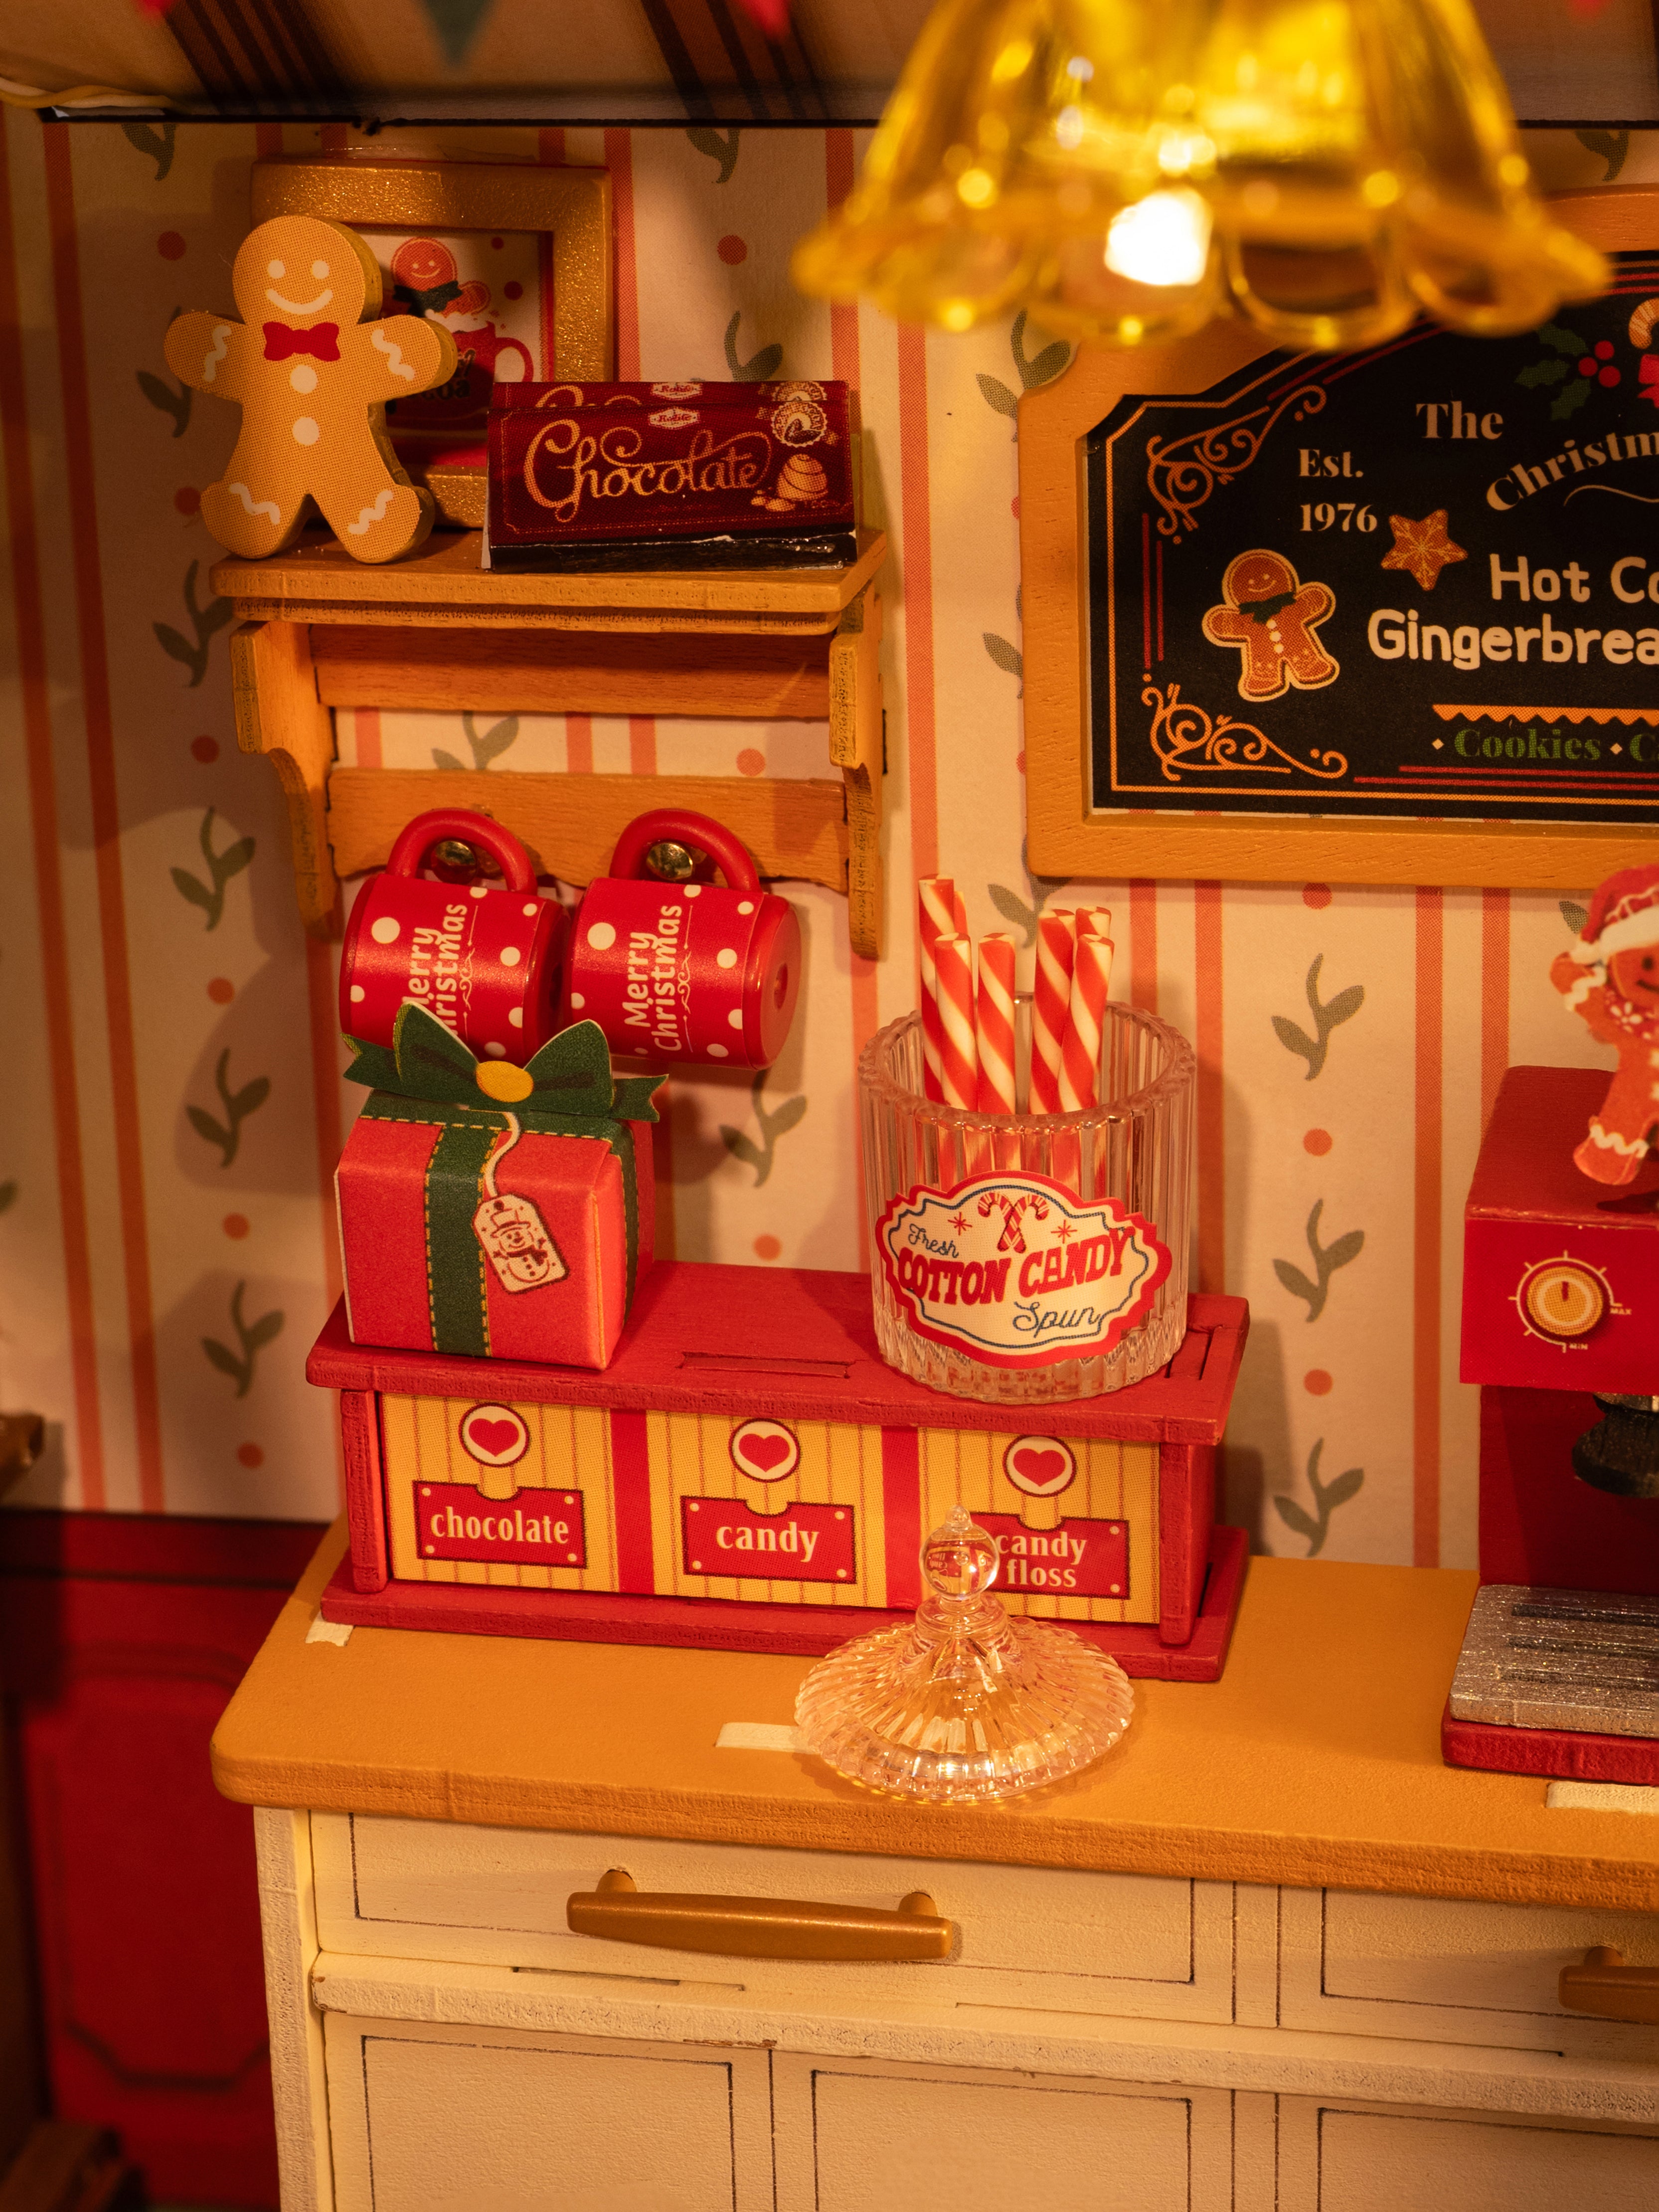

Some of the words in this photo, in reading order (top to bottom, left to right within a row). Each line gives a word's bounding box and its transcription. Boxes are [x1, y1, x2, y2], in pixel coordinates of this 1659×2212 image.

[1416, 401, 1503, 440] The
[524, 418, 772, 522] Chocolate
[1298, 448, 1364, 478] Est.
[1300, 503, 1378, 533] 1976
[1490, 553, 1591, 603] Hot
[1367, 608, 1659, 670] Gingerbrea
[1454, 728, 1601, 761] Cookies
[432, 904, 468, 1035] ristmas
[622, 932, 658, 1027] Merry
[651, 905, 682, 1051] Christmas
[908, 1223, 959, 1259] Fresh
[898, 1246, 1011, 1306] COTTON
[1018, 1225, 1137, 1298] CANDY
[1012, 1301, 1101, 1339] Spun
[430, 1506, 569, 1544] chocolate
[715, 1521, 820, 1563] candy
[995, 1531, 1087, 1565] candy
[1007, 1558, 1077, 1588] floss
